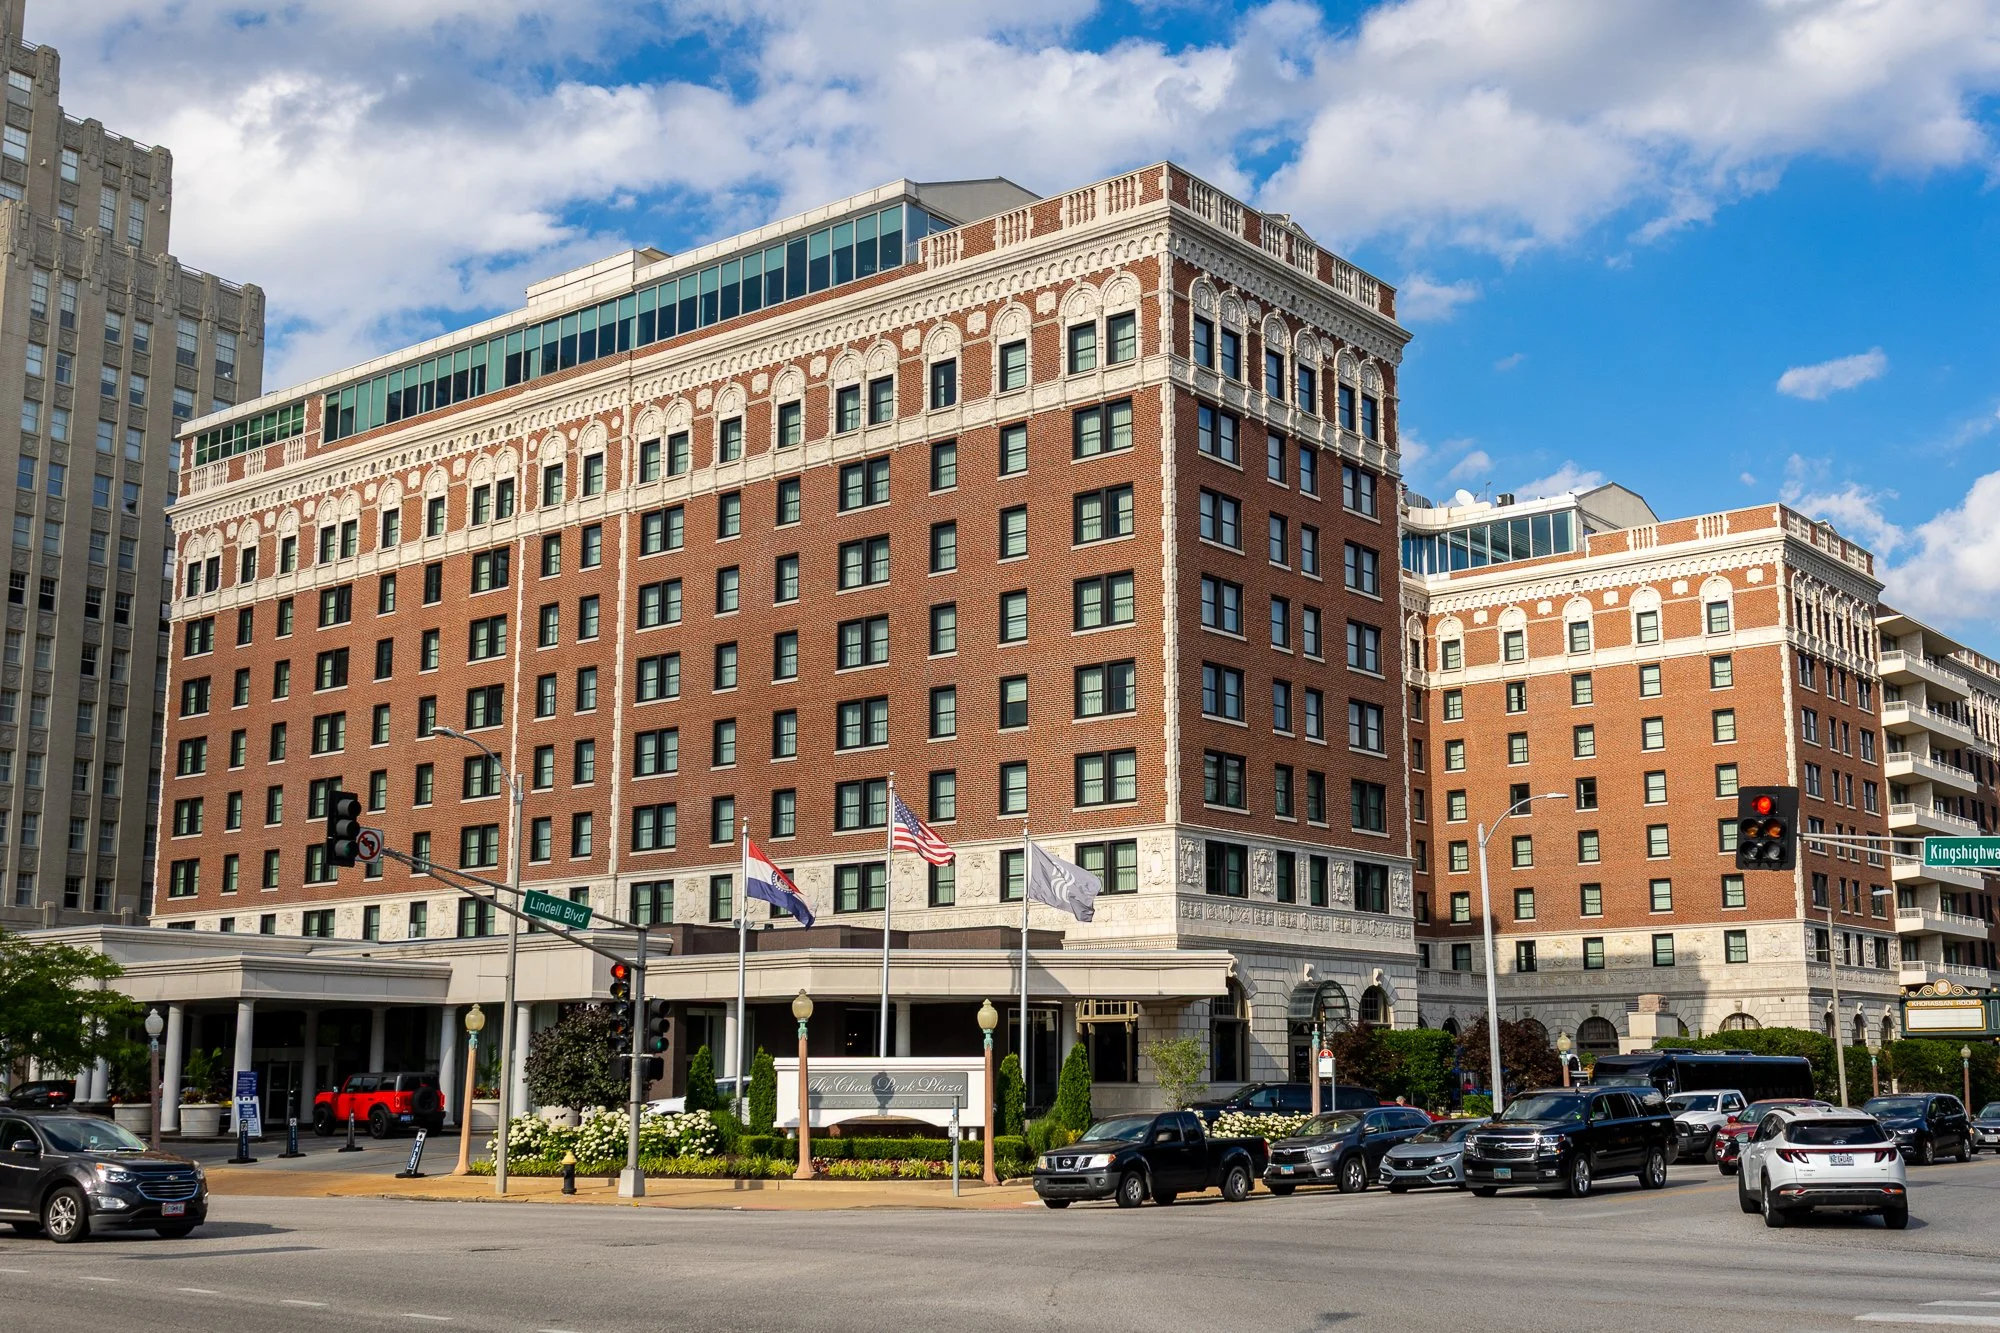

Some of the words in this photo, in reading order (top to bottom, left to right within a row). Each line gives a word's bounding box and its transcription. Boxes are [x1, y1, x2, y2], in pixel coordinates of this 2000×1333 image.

[530, 897, 562, 916] Lindell
[563, 906, 586, 923] Blvd
[808, 1076, 833, 1092] The
[833, 1076, 875, 1092] Chase
[875, 1076, 917, 1092] Park
[917, 1076, 964, 1092] Plaza
[410, 1142, 420, 1168] VALET
